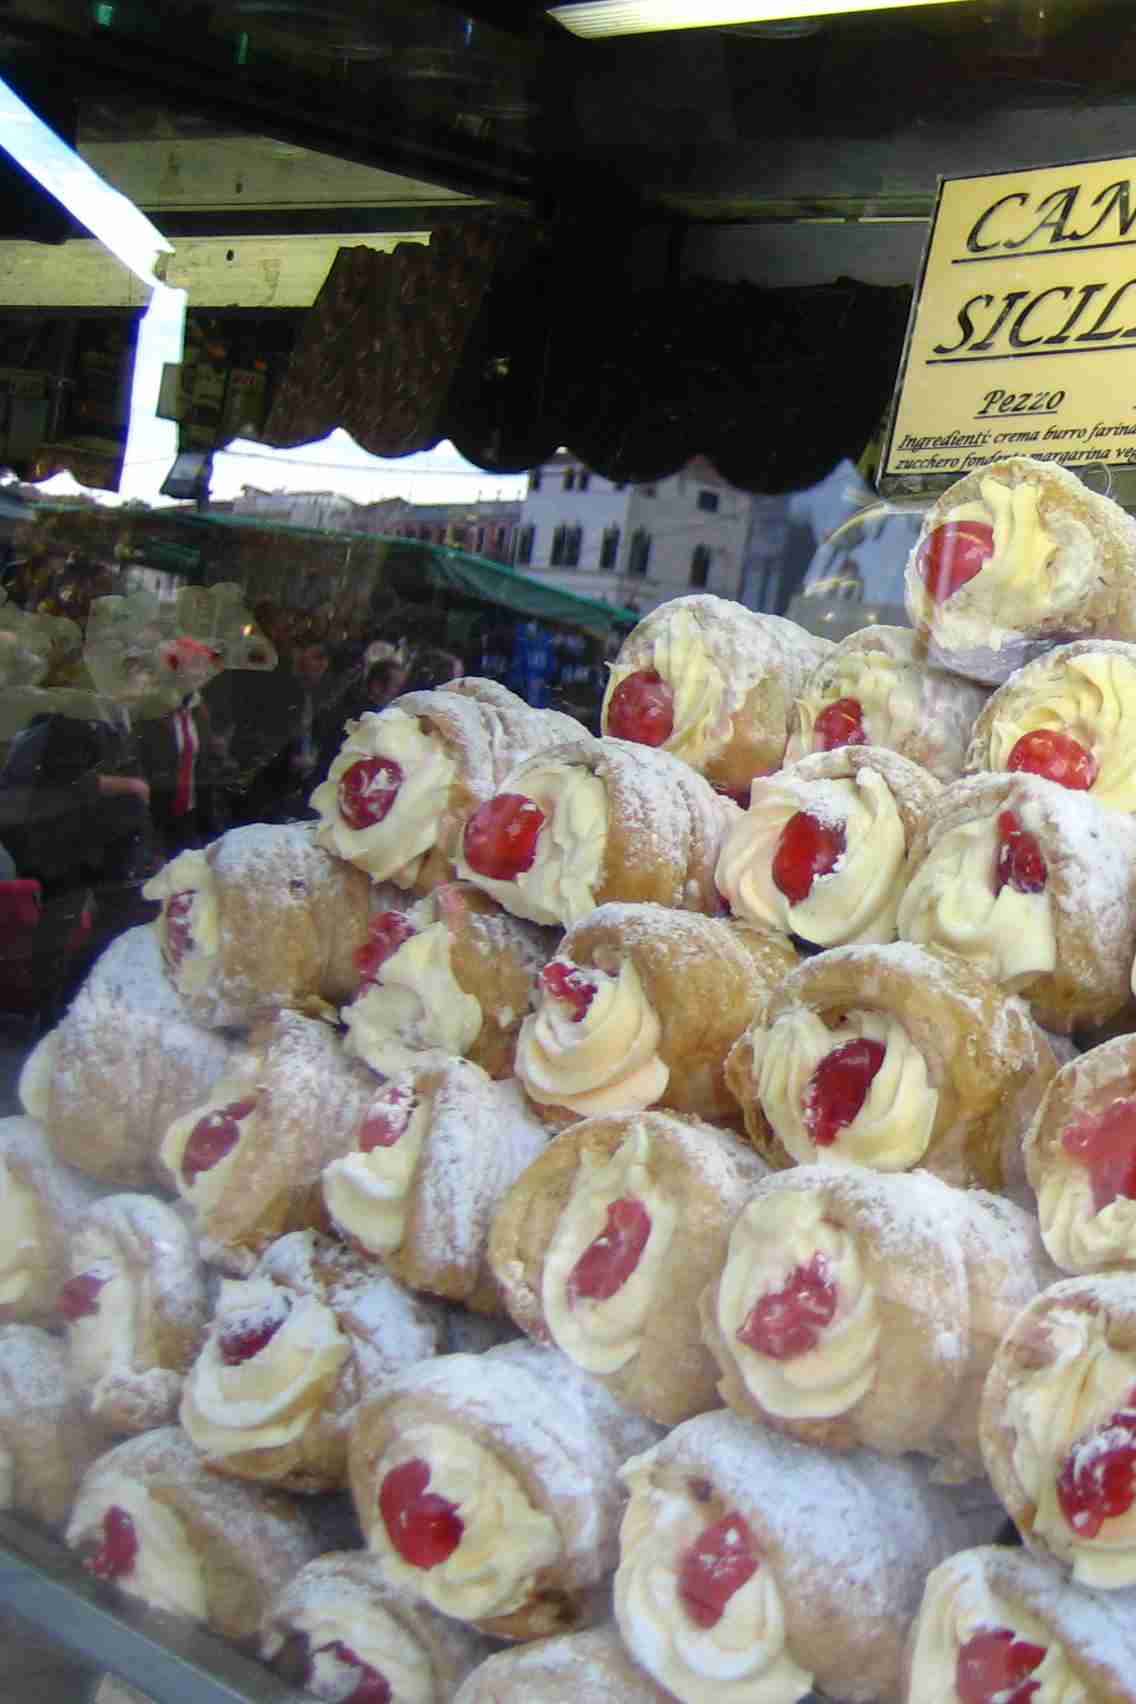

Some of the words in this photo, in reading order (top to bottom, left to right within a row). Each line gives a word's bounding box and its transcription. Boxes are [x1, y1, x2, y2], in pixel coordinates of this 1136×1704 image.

[977, 388, 1066, 416] Pezzo
[992, 430, 1039, 445] crema
[1042, 424, 1088, 441] burro
[895, 453, 960, 470] zucchero
